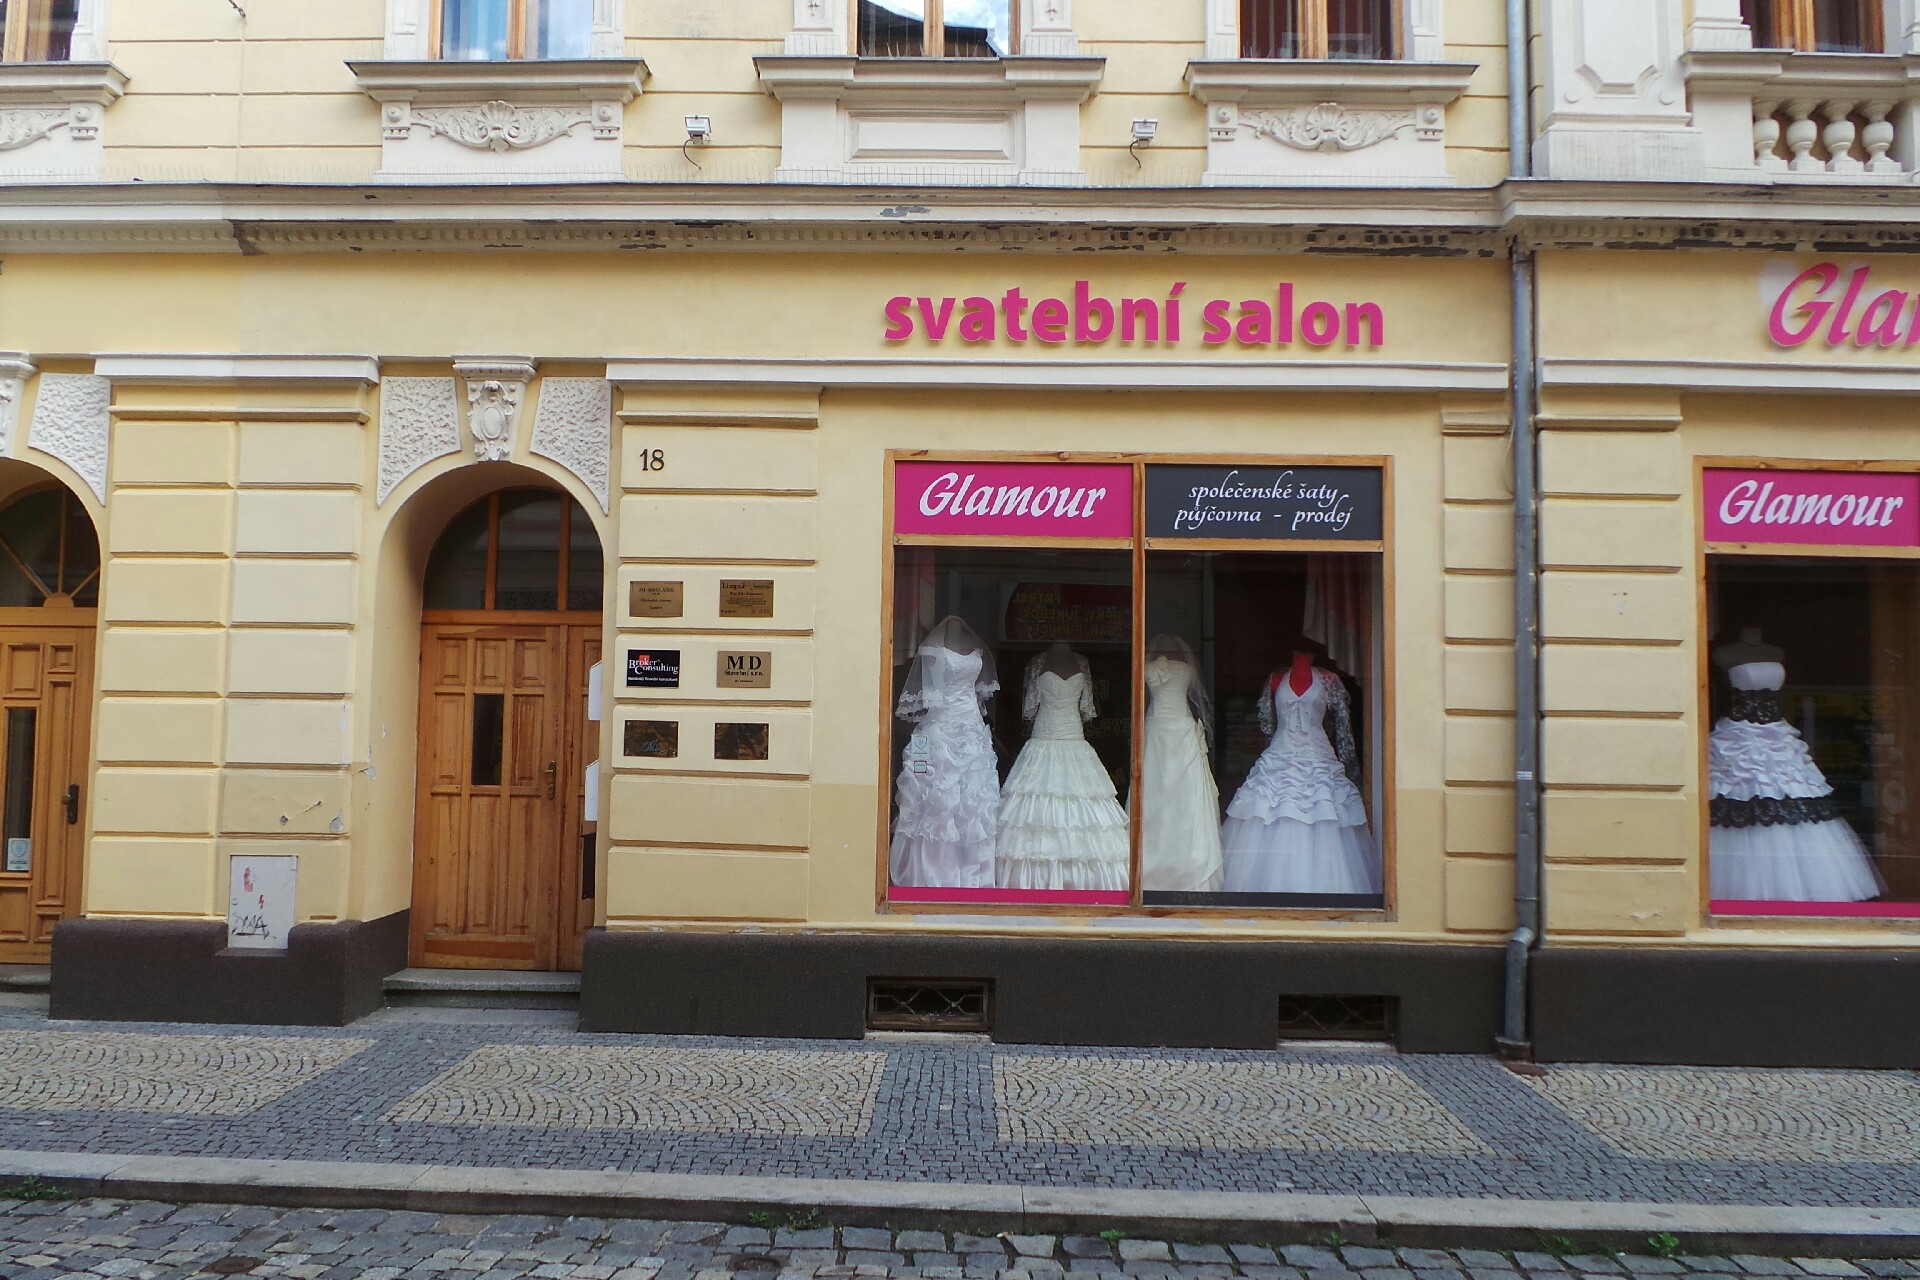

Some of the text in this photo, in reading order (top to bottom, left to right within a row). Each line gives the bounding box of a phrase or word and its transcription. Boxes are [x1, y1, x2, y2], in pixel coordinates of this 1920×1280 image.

[884, 280, 1384, 346] svatební salon
[1768, 261, 1920, 347] Gla
[639, 448, 665, 471] 18
[919, 472, 1107, 519] Glamour
[1188, 470, 1339, 508] společenské šaty
[1719, 479, 1904, 527] Glamour
[1173, 504, 1262, 531] půjčovna
[1291, 494, 1354, 532] prodej
[628, 657, 658, 669] Broker
[634, 662, 679, 675] Consulting
